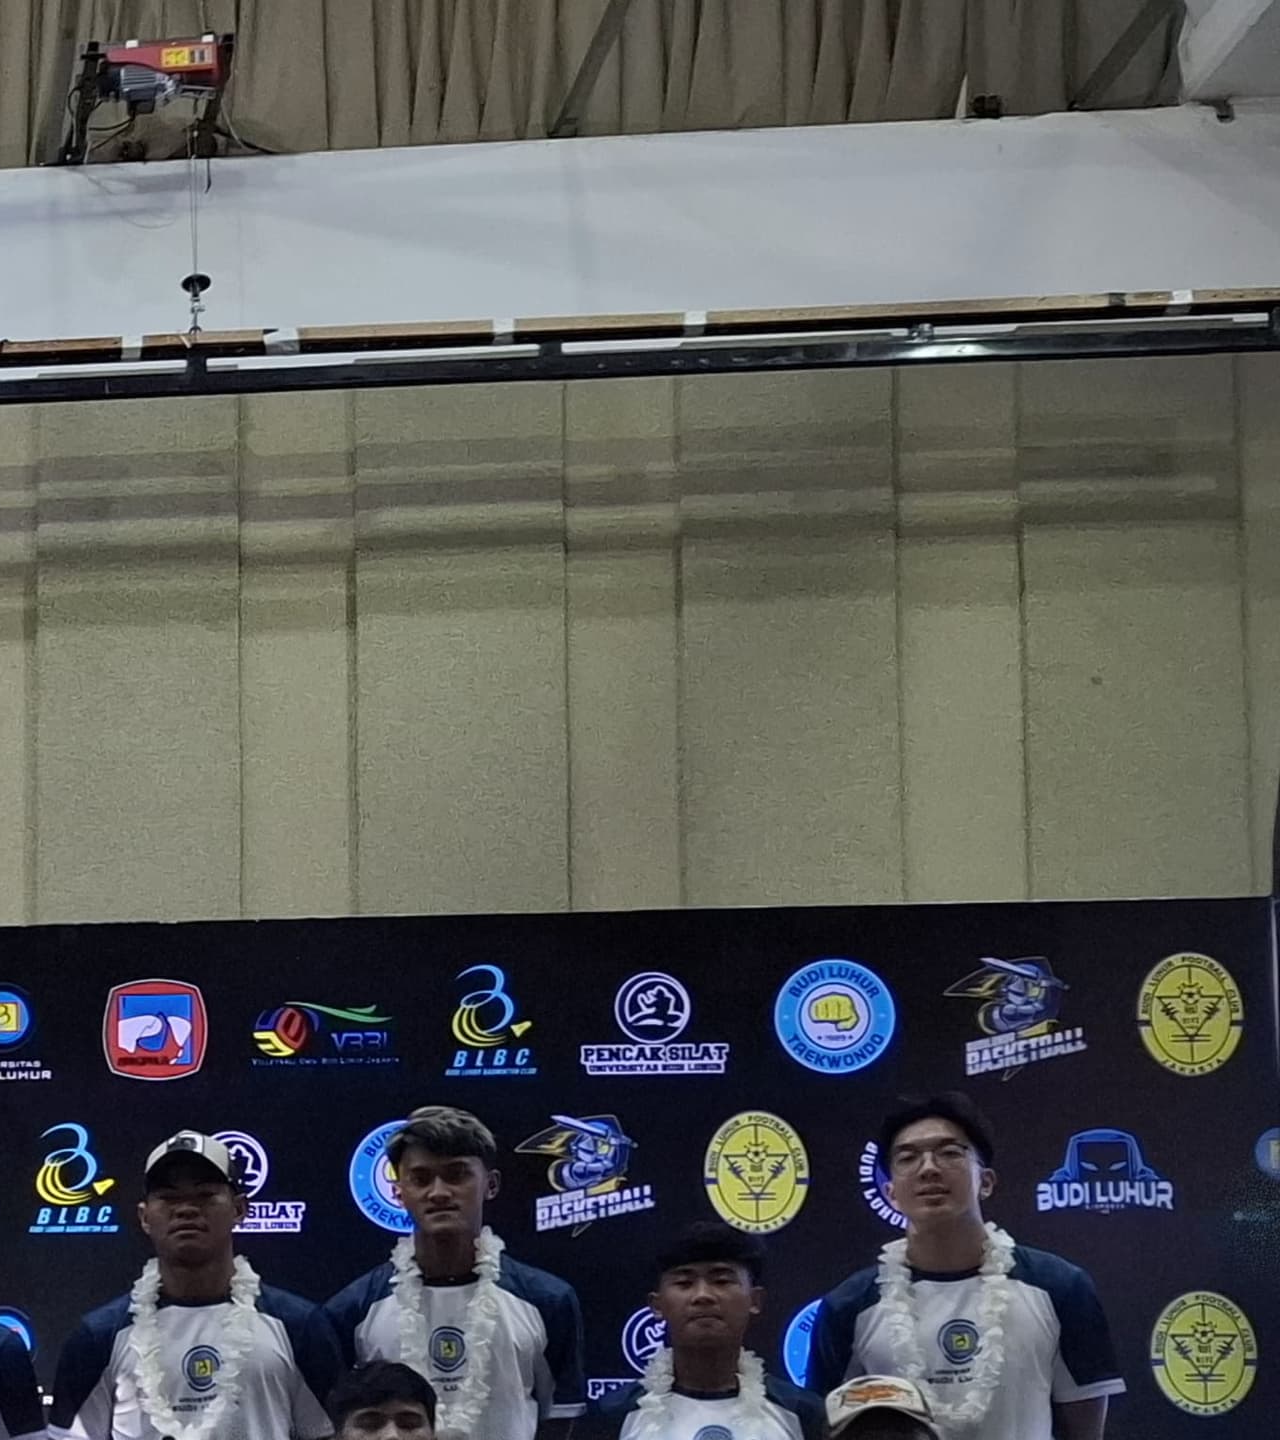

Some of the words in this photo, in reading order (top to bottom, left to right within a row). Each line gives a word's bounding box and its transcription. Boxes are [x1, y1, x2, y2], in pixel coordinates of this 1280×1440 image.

[789, 968, 825, 998] BUDI
[829, 966, 880, 998] LUHUR
[583, 1046, 664, 1062] PENCAK
[668, 1045, 727, 1061] SILAT
[787, 1033, 884, 1068] TAEKWONDO
[966, 1027, 1088, 1076] BASKETBALL
[859, 1141, 878, 1182] BUDI
[362, 1193, 413, 1227] TAEKW
[536, 1185, 655, 1231] BASKETBALL
[1037, 1182, 1089, 1212] BUDI
[1096, 1181, 1174, 1210] LUHUR
